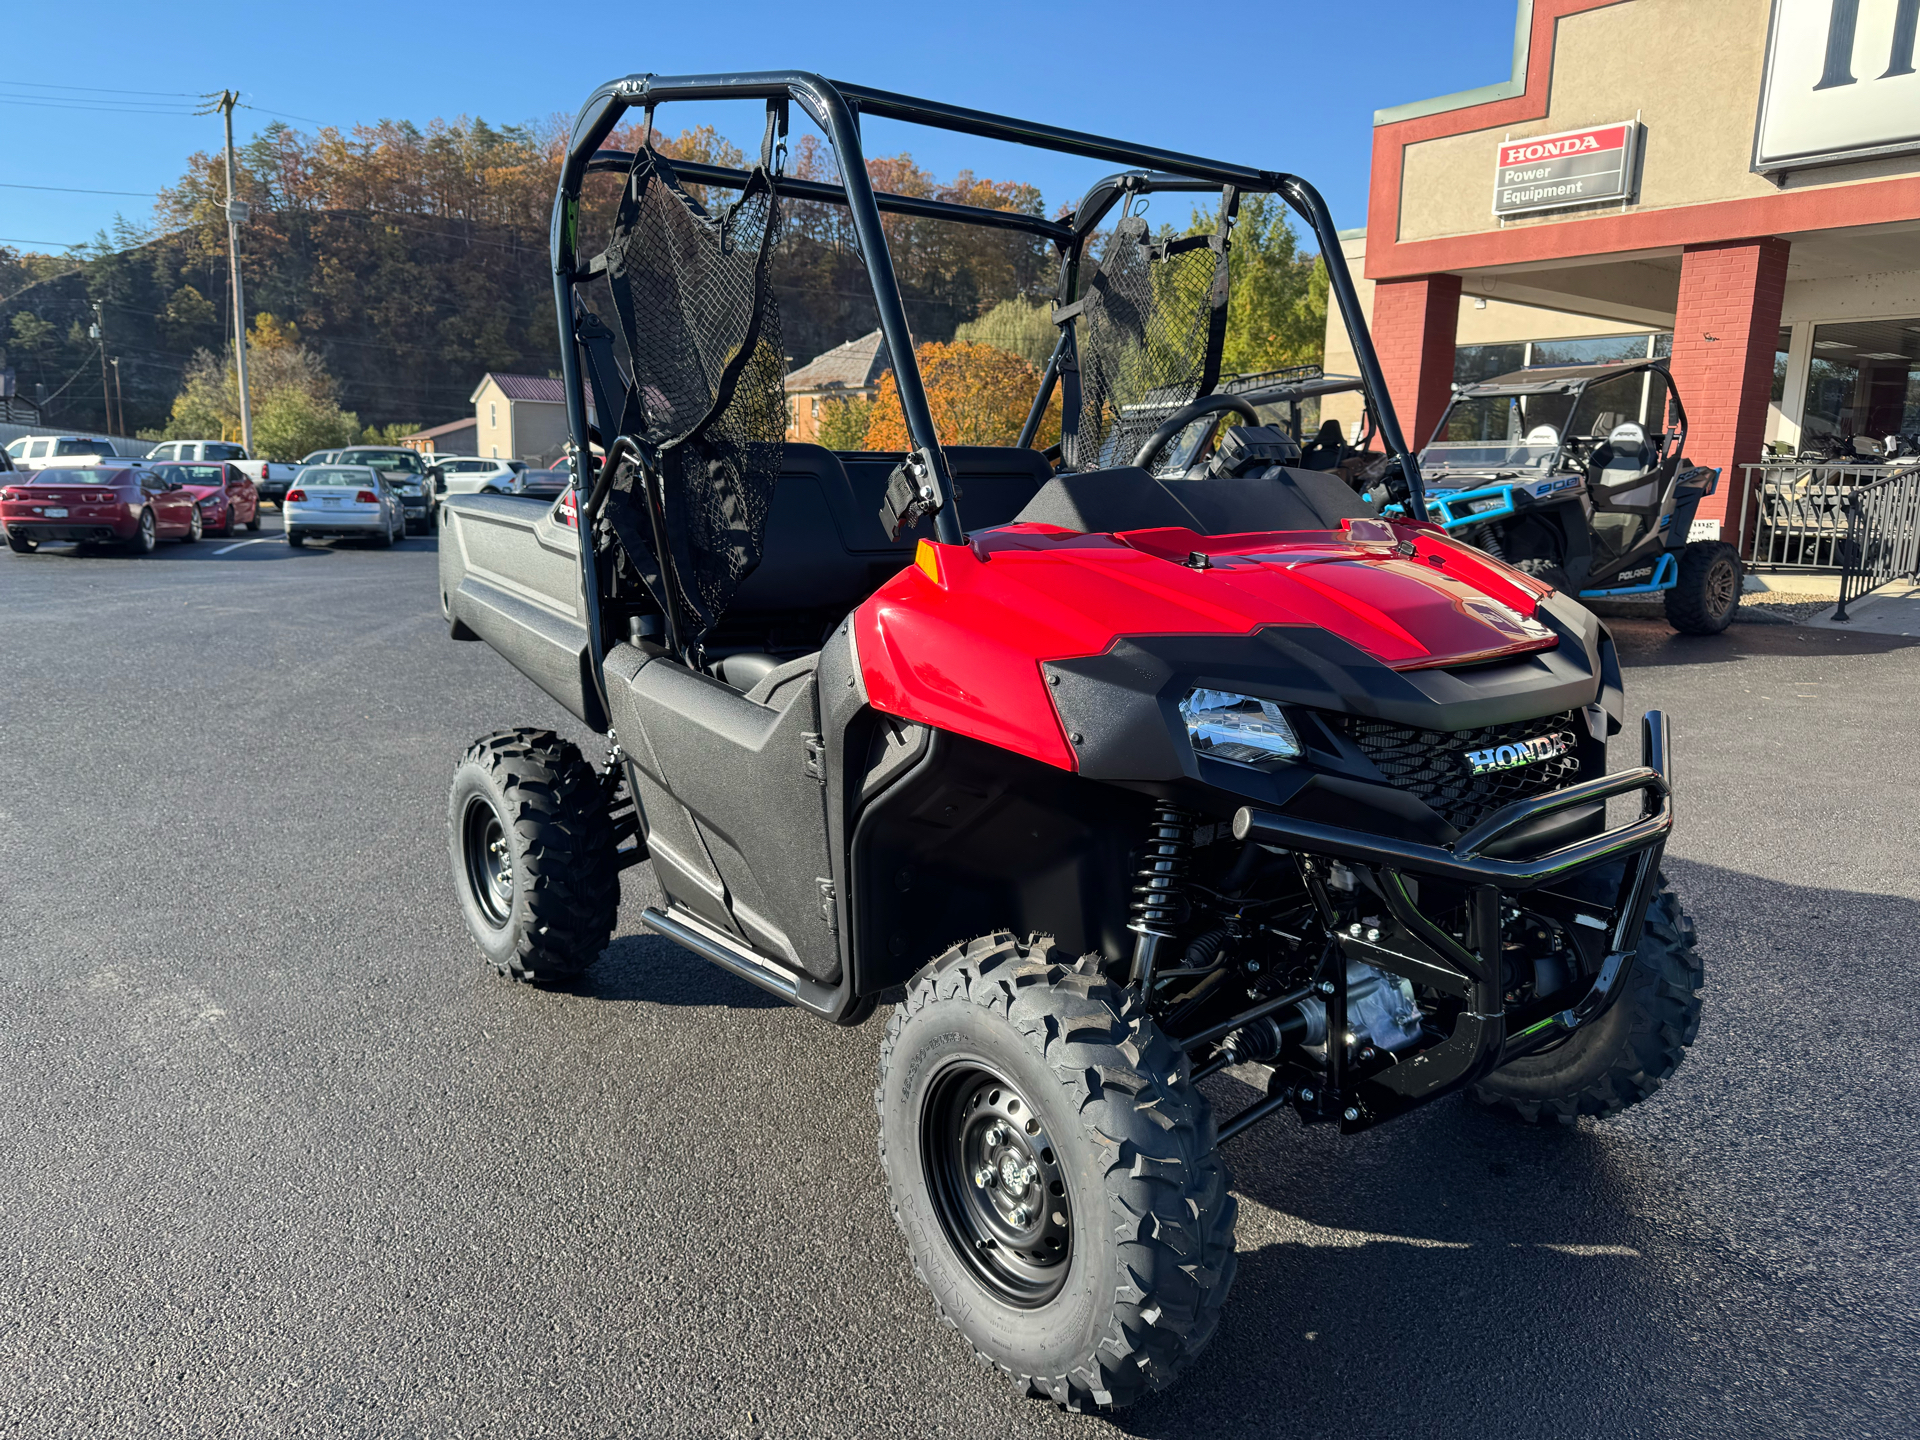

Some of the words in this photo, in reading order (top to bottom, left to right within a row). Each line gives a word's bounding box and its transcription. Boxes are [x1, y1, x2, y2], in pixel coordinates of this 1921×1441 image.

[1506, 136, 1600, 163] HONDA
[1505, 167, 1551, 184] Power
[1503, 181, 1583, 204] Equipment
[1618, 566, 1652, 581] POLARIS
[1465, 733, 1568, 775] HONDA
[901, 1193, 973, 1321] KENDA
